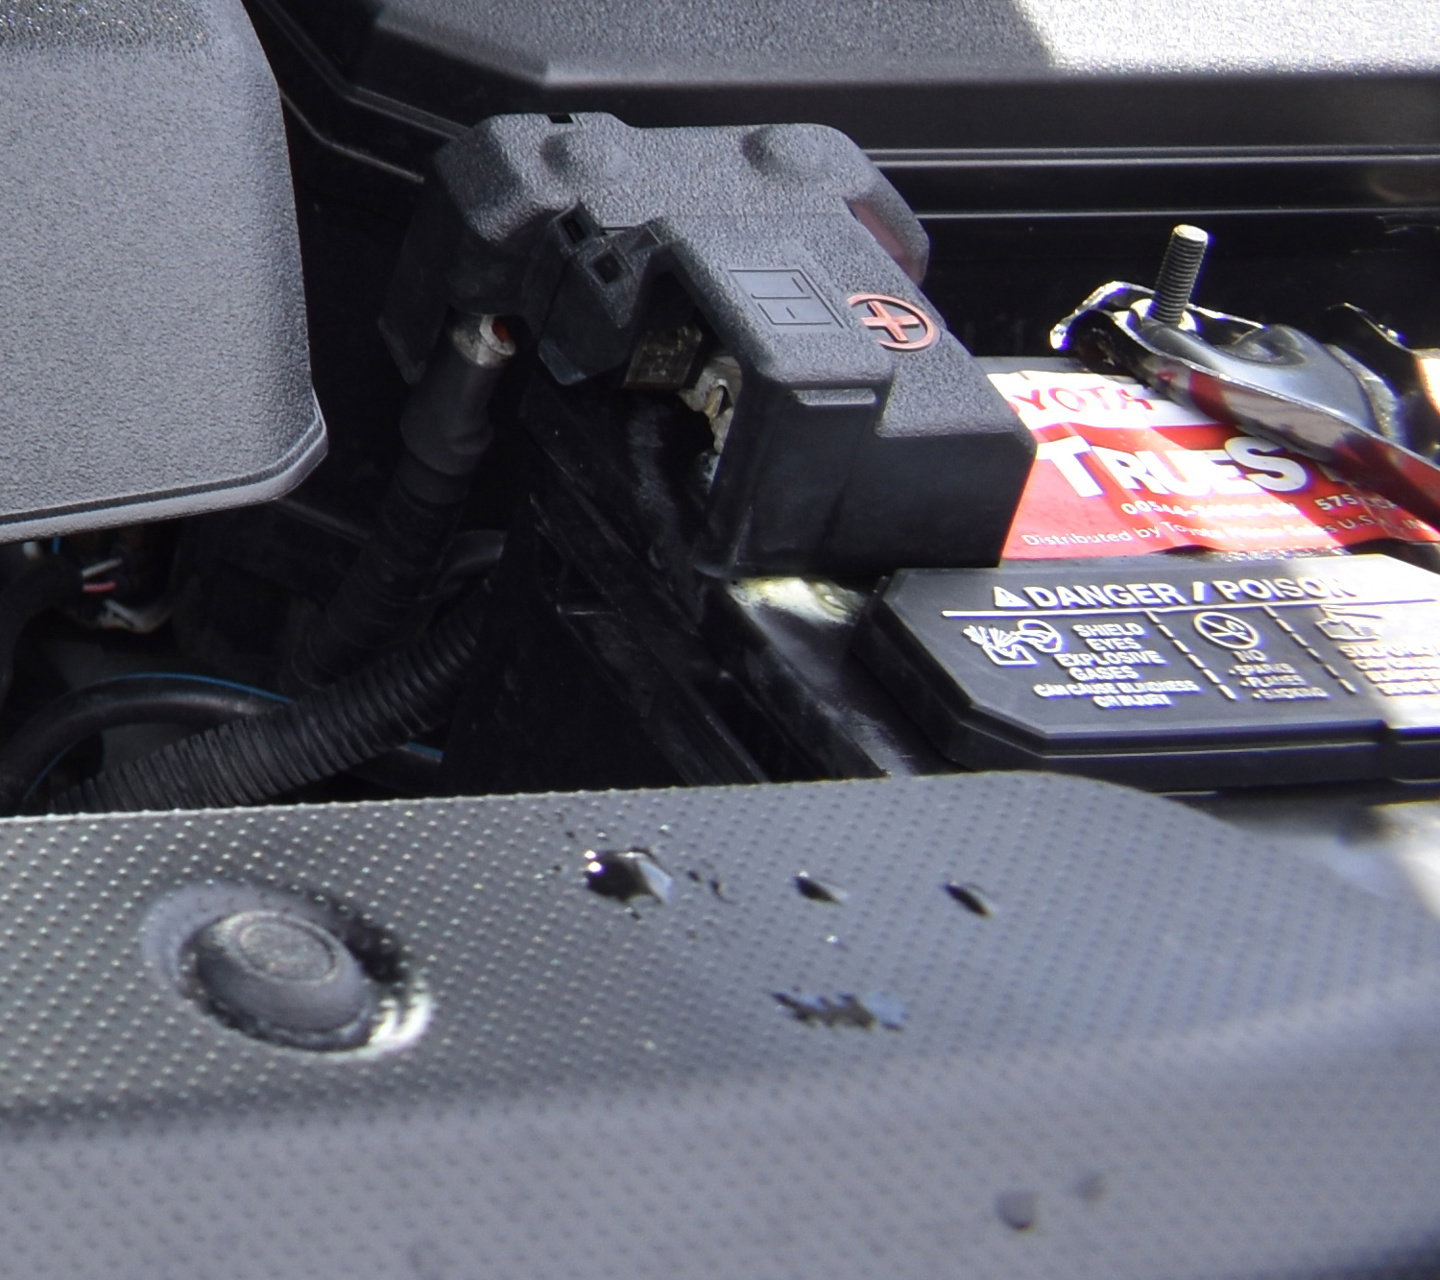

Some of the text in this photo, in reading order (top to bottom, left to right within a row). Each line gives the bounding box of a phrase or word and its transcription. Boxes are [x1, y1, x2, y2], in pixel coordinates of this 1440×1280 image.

[1010, 384, 1155, 414] YOTA
[1036, 435, 1310, 498] TRUES
[1313, 493, 1359, 511] 575
[1021, 529, 1133, 546] Distributed
[1134, 523, 1163, 539] by
[1023, 576, 1362, 609] DANGER / POISON
[1072, 622, 1146, 637] SHIELD
[1085, 637, 1142, 652] EYES
[1053, 650, 1168, 668] EXPLOSIVE
[1232, 649, 1268, 663] NO
[1068, 665, 1140, 682] GASES
[1066, 681, 1120, 696] CAUSE
